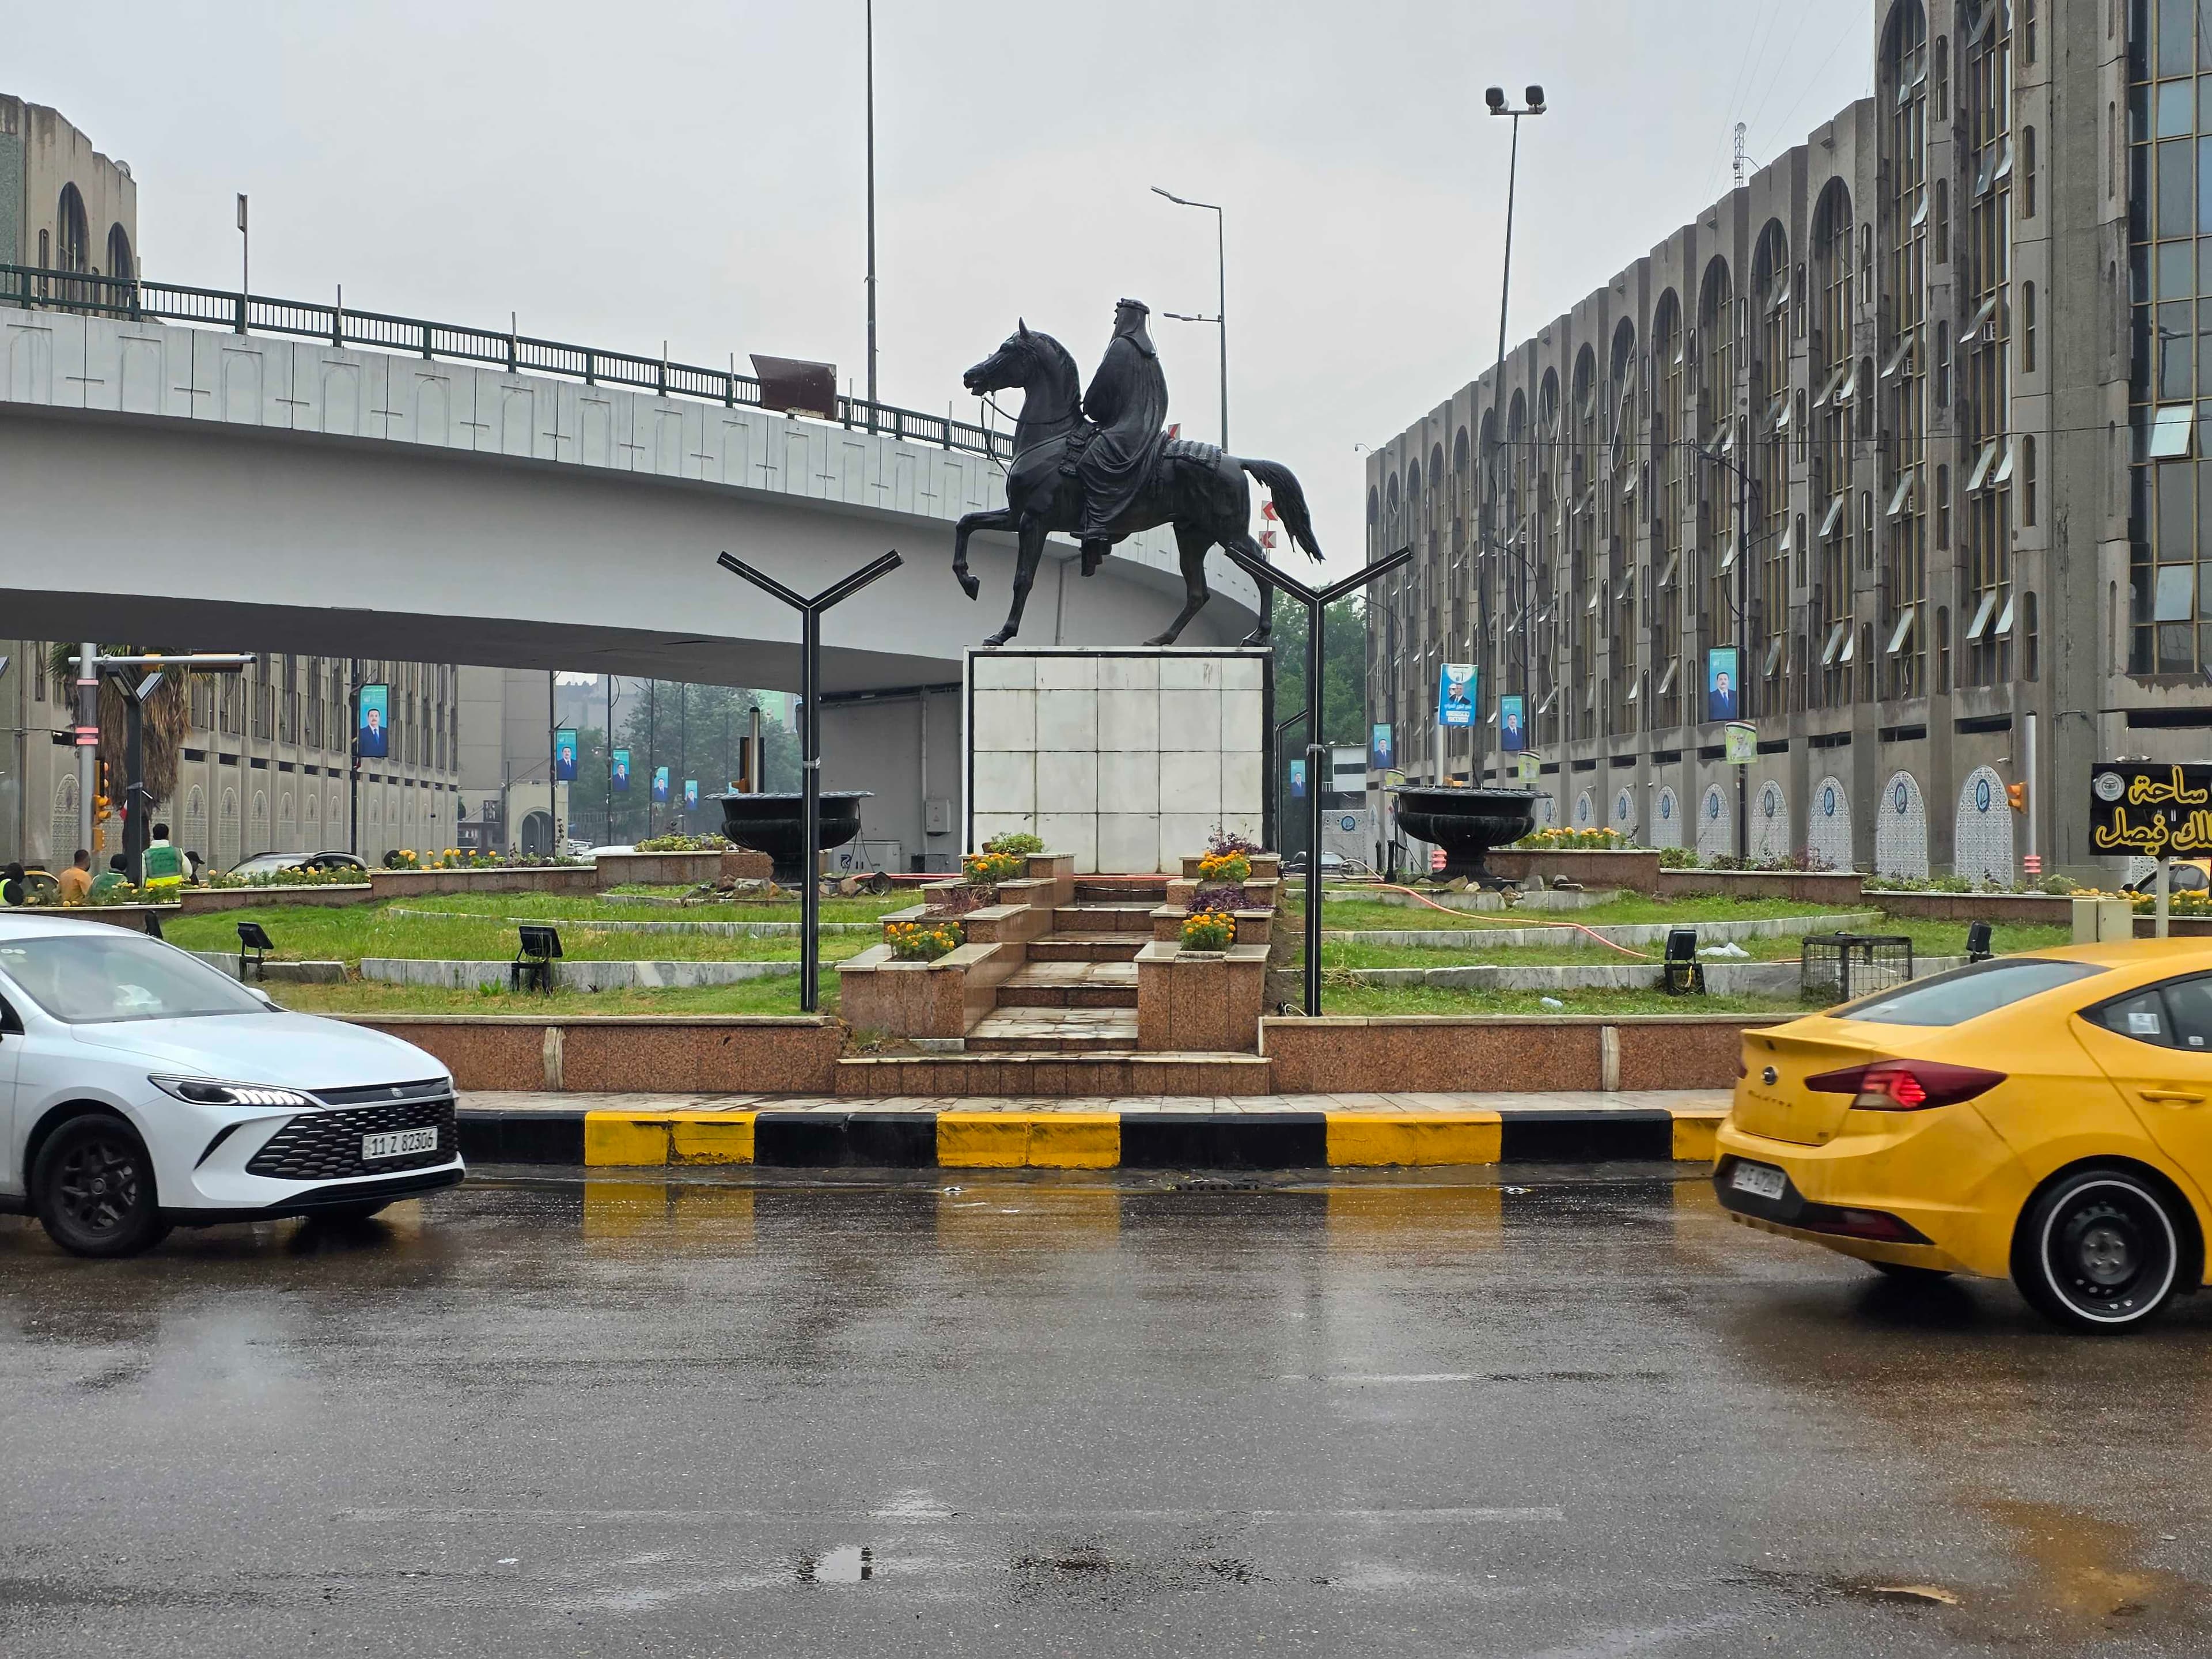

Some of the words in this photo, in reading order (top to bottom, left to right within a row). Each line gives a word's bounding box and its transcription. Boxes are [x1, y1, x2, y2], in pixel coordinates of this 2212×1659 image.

[2128, 765, 2207, 805] ساحة
[2095, 806, 2169, 855] فيصل
[372, 1137, 385, 1156] 11
[391, 1135, 397, 1153] Z
